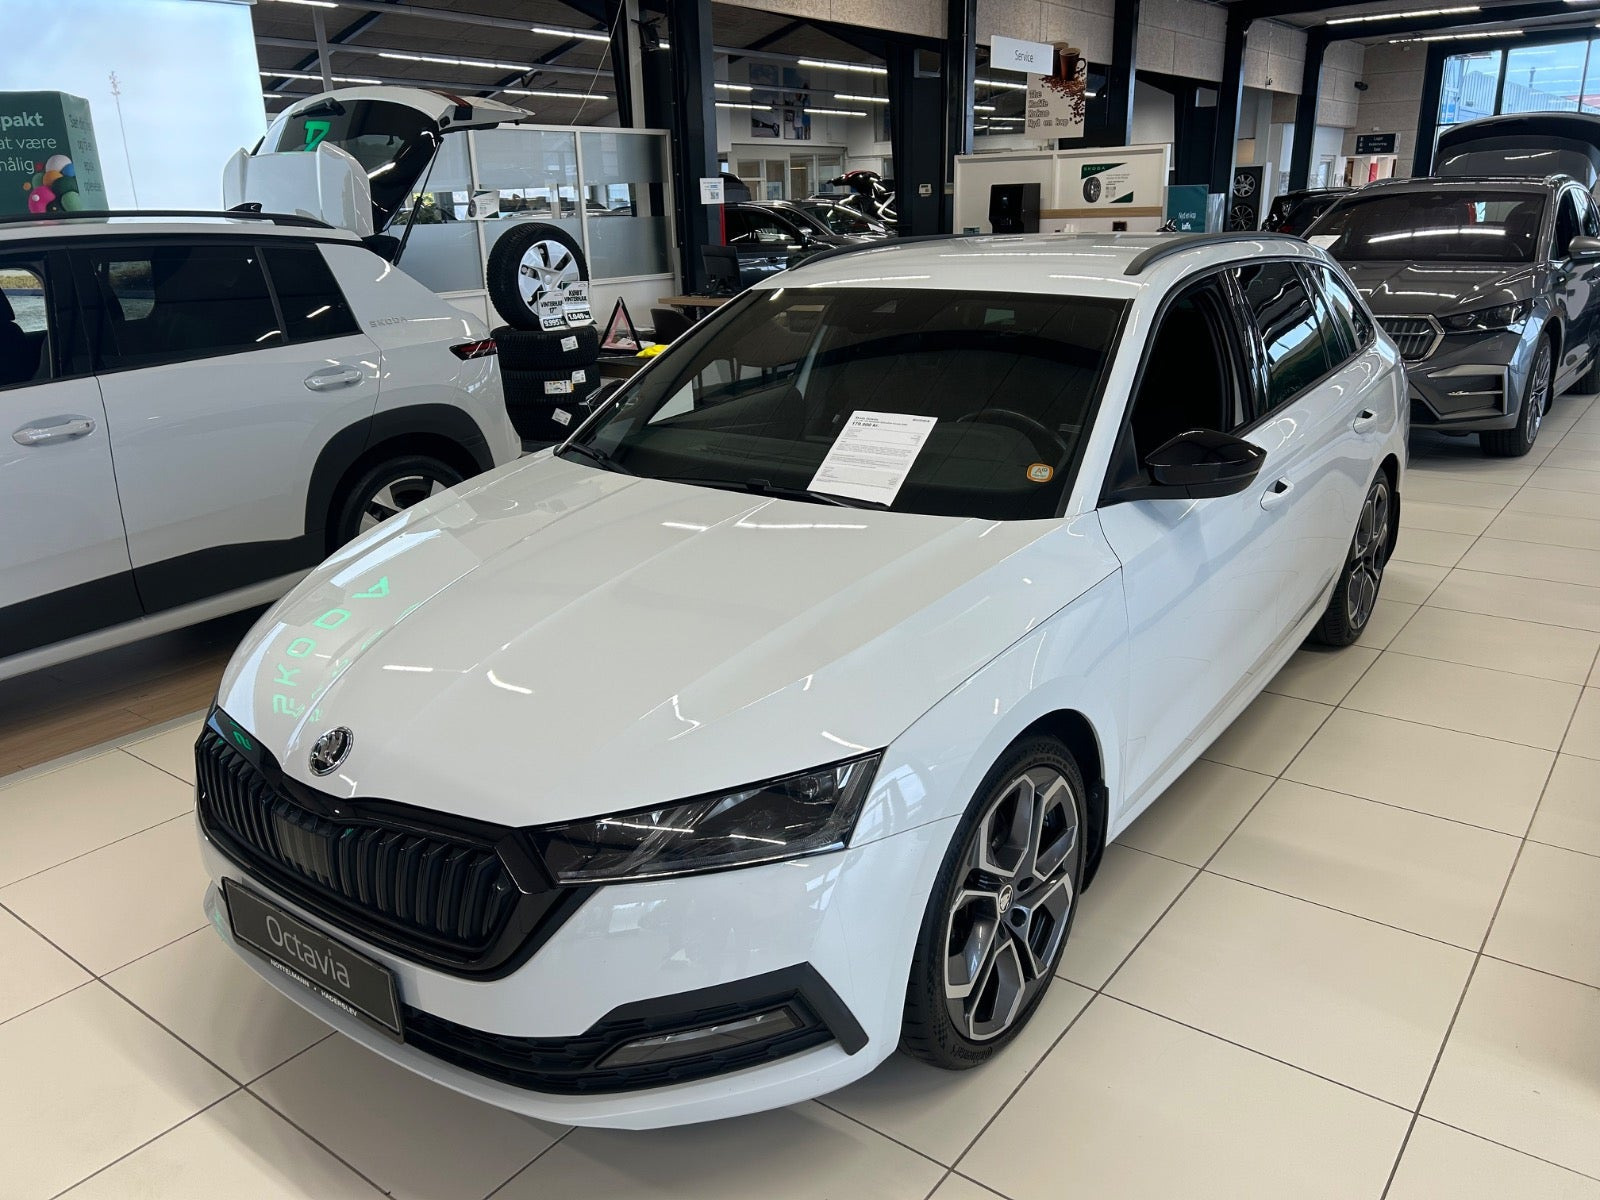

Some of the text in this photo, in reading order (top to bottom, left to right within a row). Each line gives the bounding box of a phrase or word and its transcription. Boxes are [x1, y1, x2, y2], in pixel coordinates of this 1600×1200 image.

[1014, 50, 1034, 63] Service
[0, 111, 44, 131] pakt
[15, 138, 57, 149] være
[266, 915, 351, 989] Octavia
